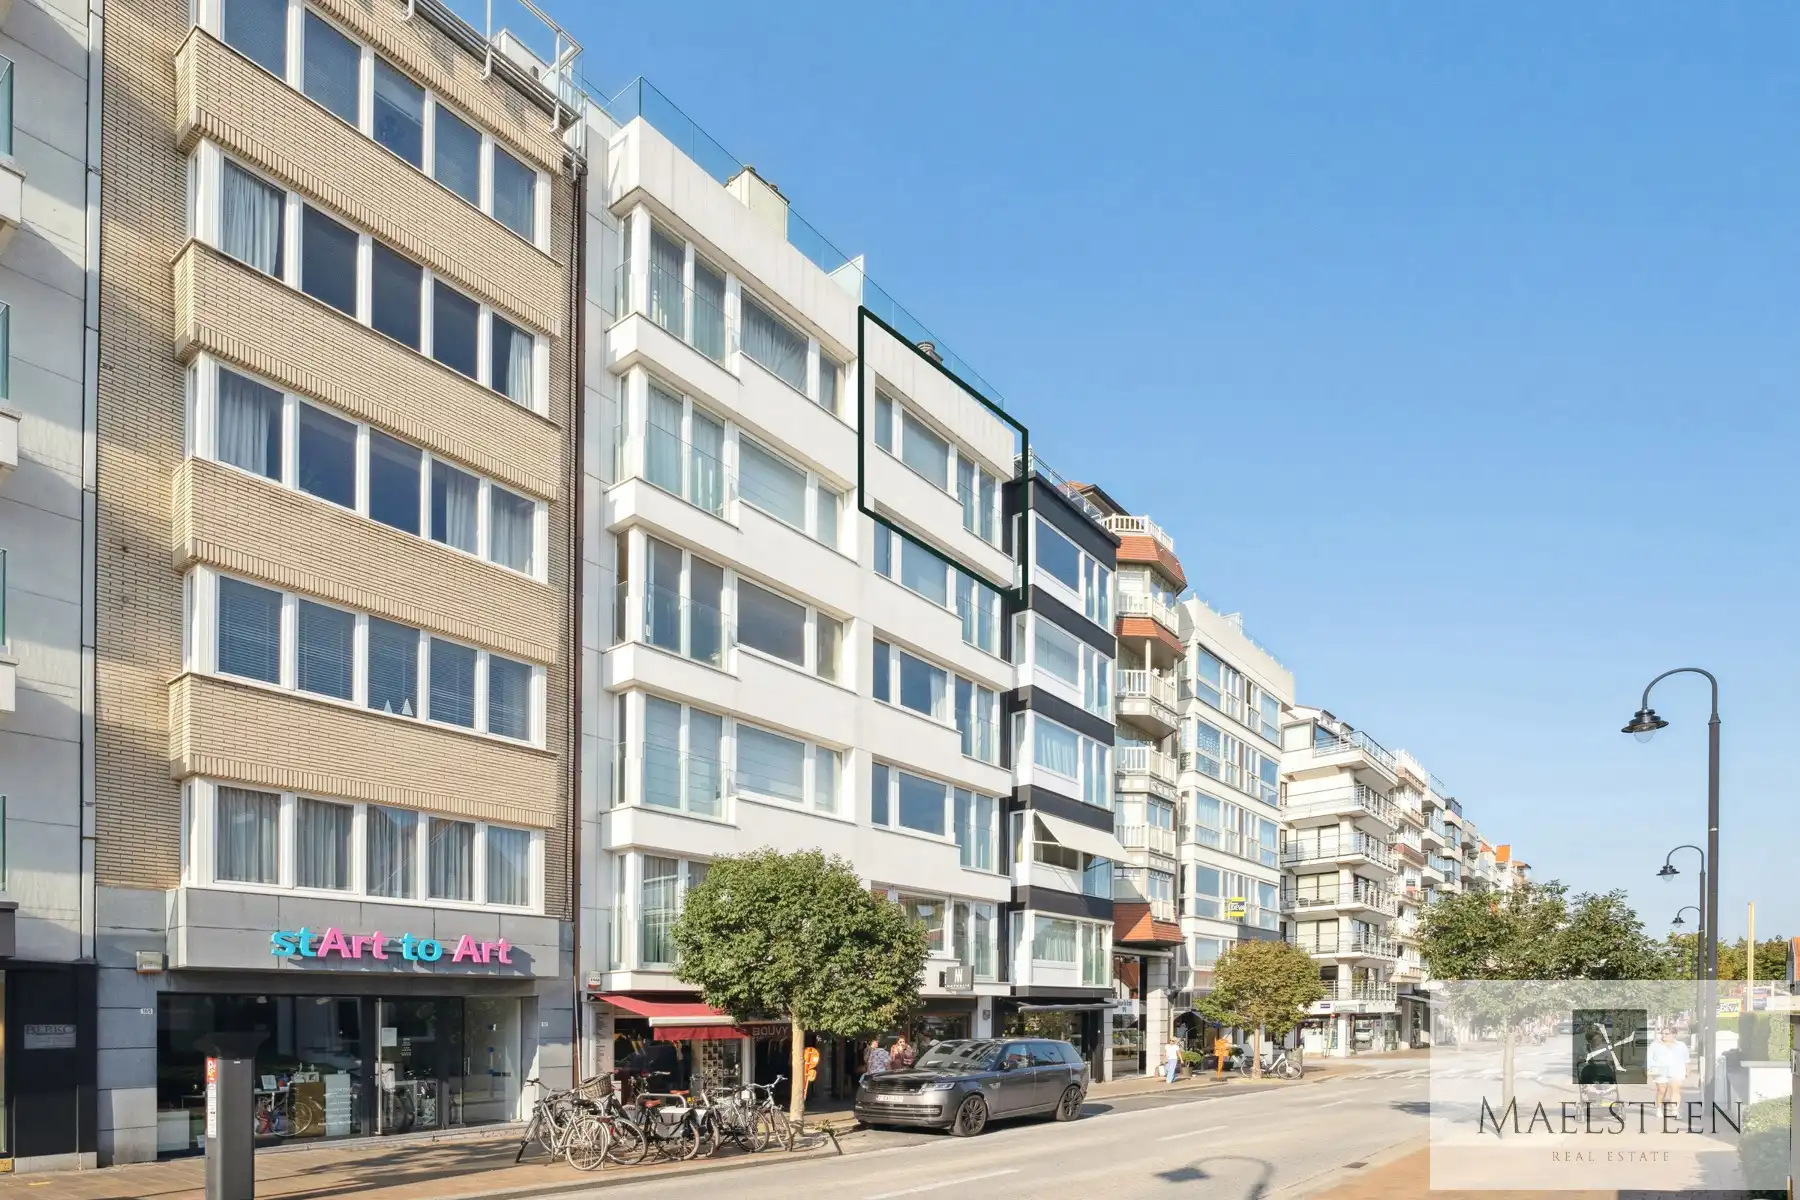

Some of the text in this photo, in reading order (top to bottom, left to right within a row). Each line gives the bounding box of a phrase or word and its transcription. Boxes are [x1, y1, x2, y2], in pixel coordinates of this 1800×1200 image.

[270, 927, 513, 964] stArt to Art
[752, 1025, 789, 1036] BOUVY
